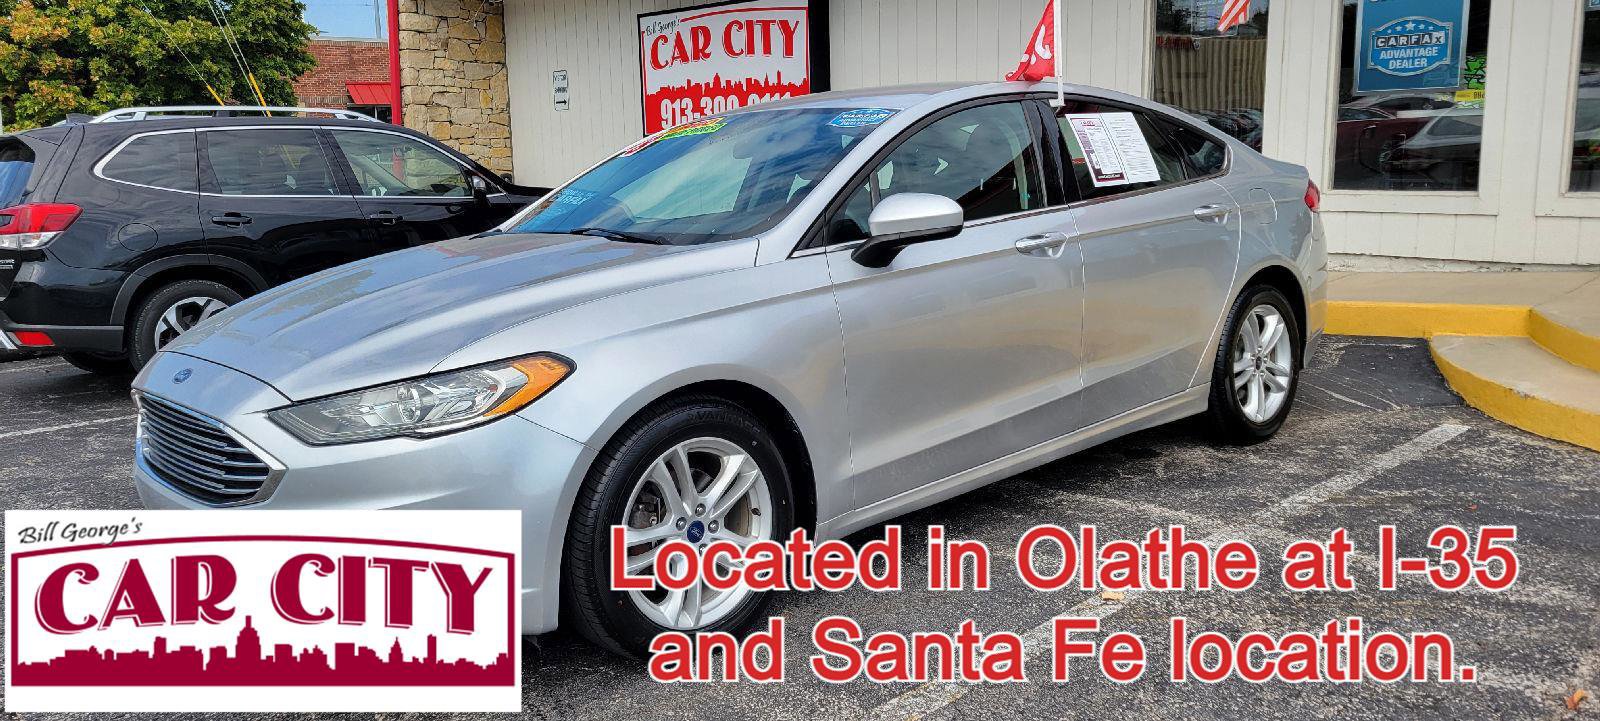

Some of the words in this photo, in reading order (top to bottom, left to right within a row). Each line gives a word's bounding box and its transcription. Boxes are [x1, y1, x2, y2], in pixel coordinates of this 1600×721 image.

[650, 25, 712, 71] CAR
[722, 19, 799, 58] CITY
[1376, 31, 1445, 48] CARFAX
[1380, 46, 1438, 60] ADVANTAGE
[1389, 57, 1428, 70] DEALER
